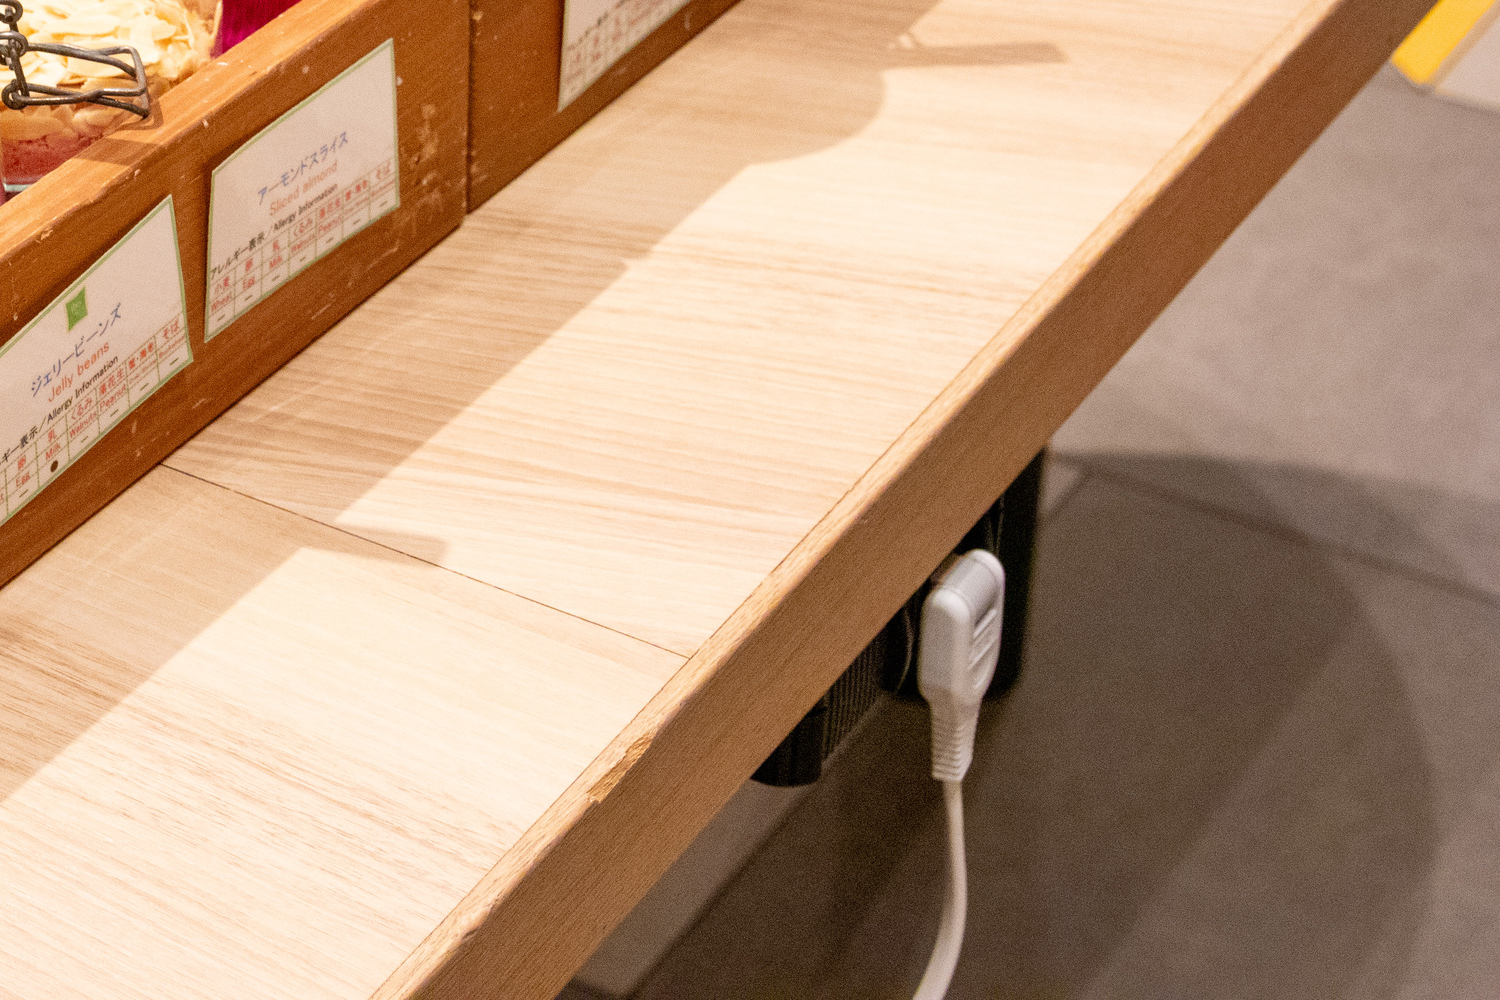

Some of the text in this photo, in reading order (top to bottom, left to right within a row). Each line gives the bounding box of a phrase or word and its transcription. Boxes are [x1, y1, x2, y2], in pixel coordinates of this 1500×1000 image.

[257, 131, 347, 204] アーモンドスライス
[269, 185, 299, 216] Sliced
[302, 158, 337, 192] almond
[298, 183, 337, 215] Information
[242, 276, 255, 291] Egg
[269, 255, 282, 268] Milk
[31, 302, 121, 397] ジェリービーンズ
[47, 373, 73, 402] Jelly
[76, 341, 109, 376] beans
[71, 398, 92, 419] くるみ
[162, 320, 178, 339] そば
[74, 355, 118, 398] Information
[15, 471, 30, 490] Egg
[45, 443, 60, 459] Milk
[69, 411, 96, 437] Walnuts
[99, 384, 126, 410] Peanut
